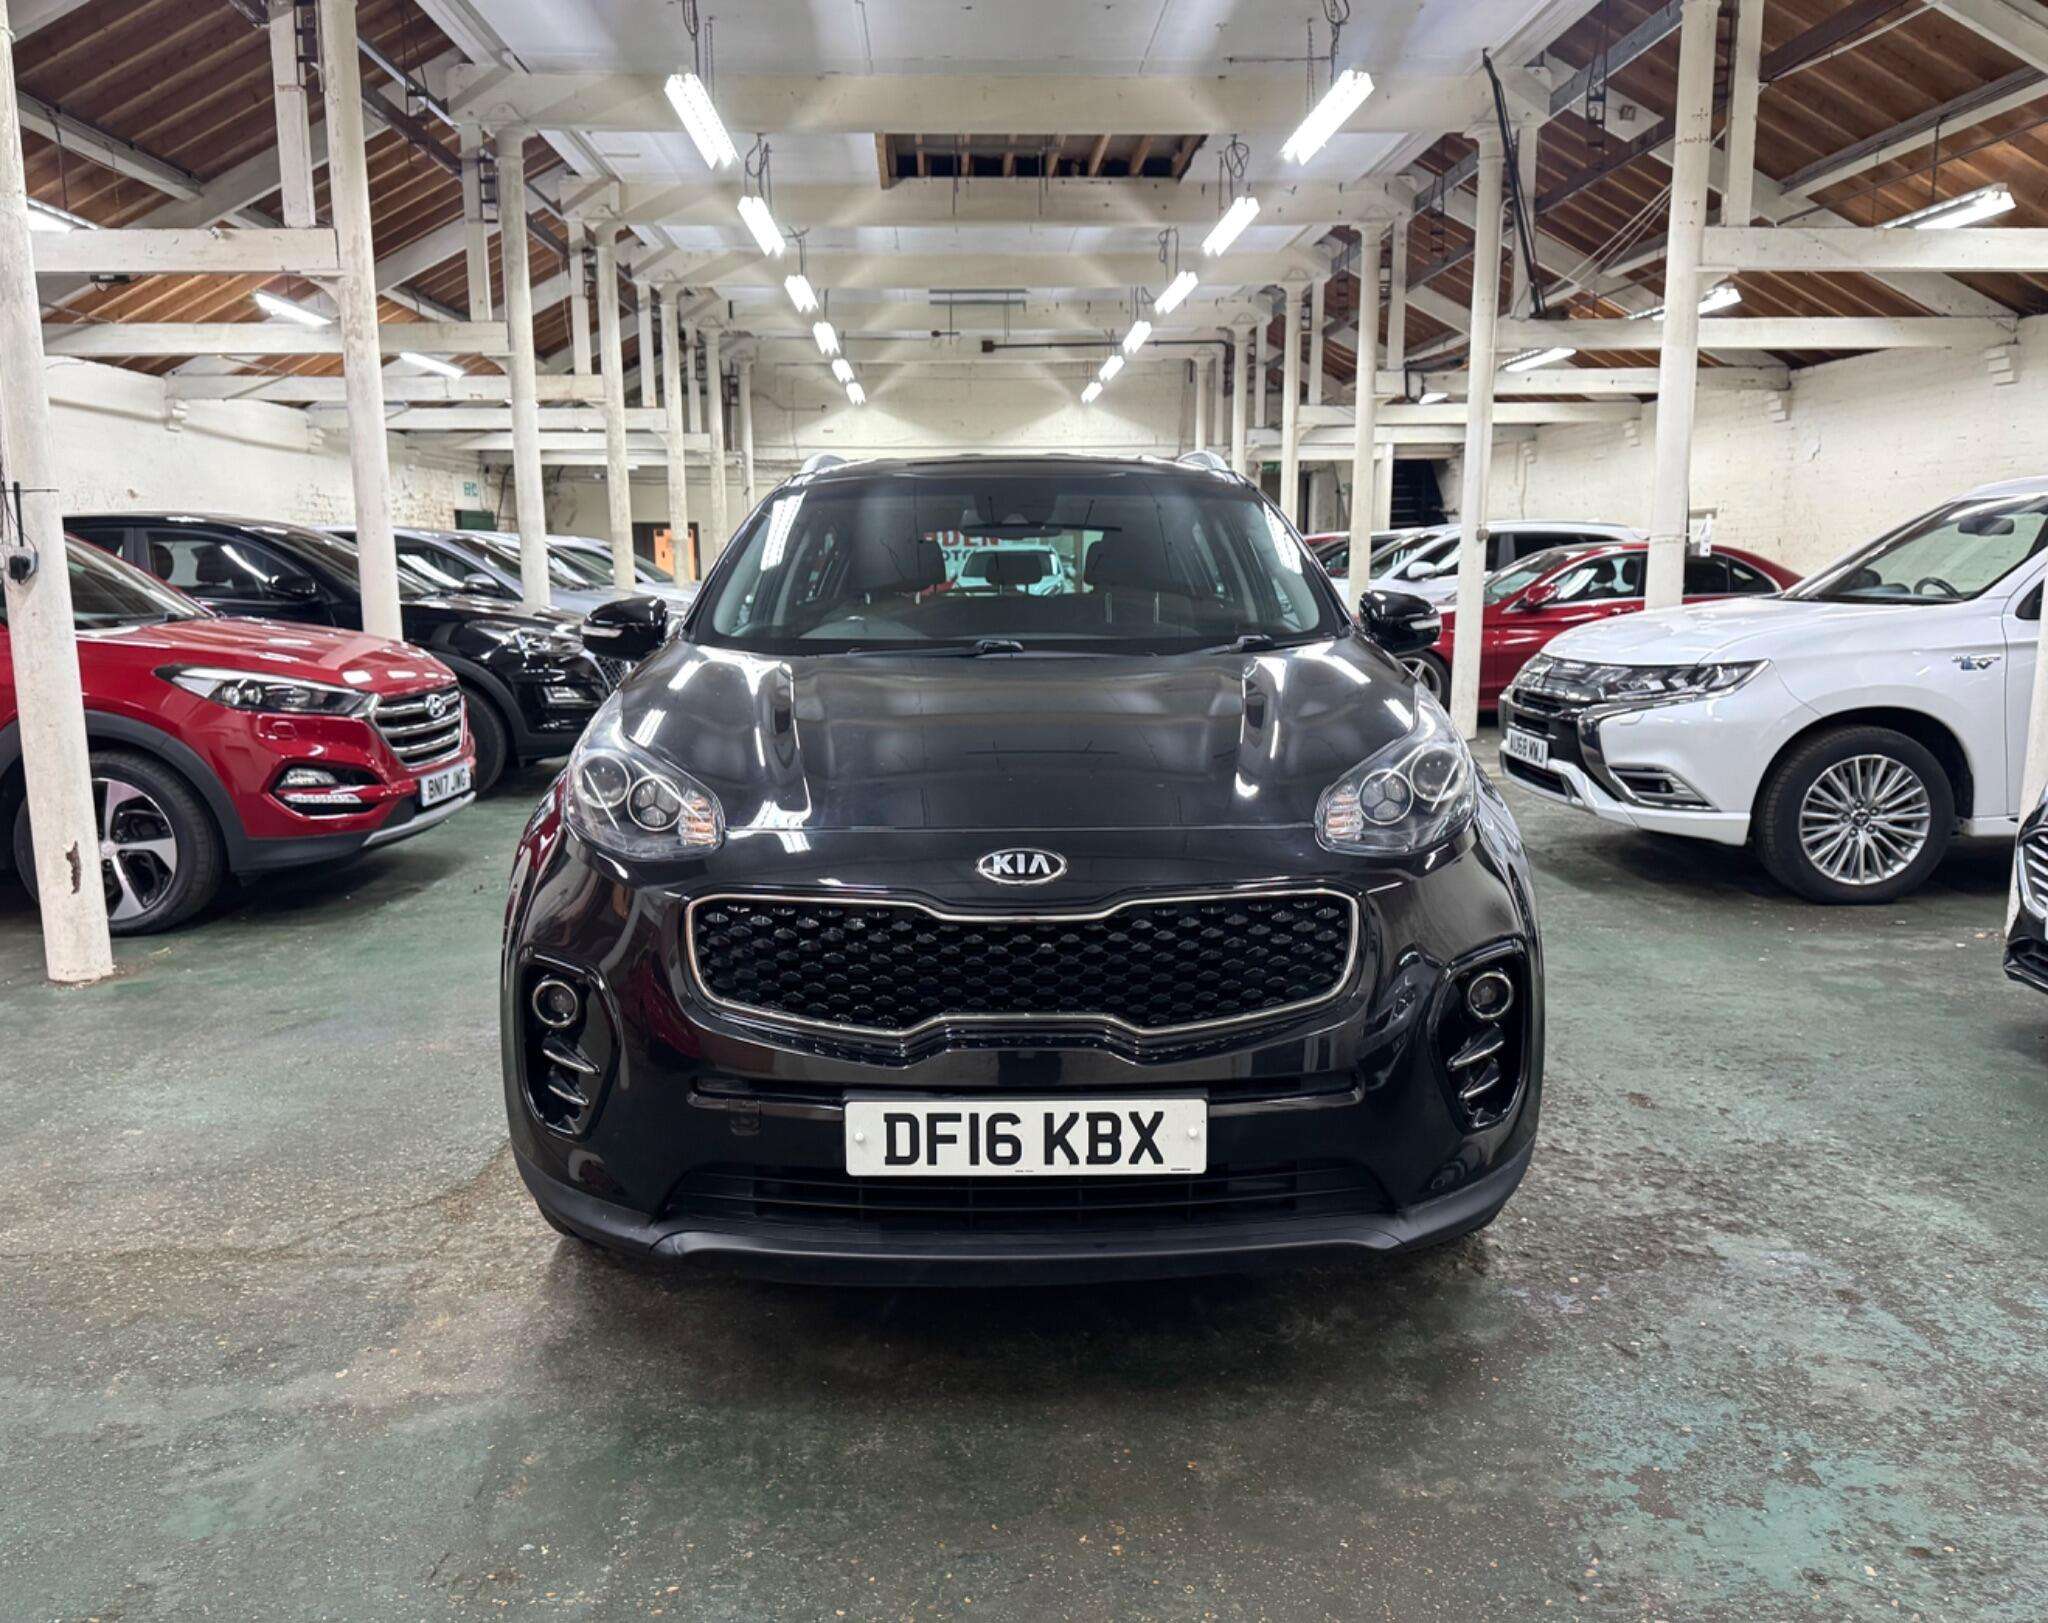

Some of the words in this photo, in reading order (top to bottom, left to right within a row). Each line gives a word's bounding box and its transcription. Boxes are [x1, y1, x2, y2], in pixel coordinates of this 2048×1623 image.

[993, 853, 1051, 874] KIA
[884, 1112, 1022, 1166] DF16
[1043, 1111, 1165, 1165] KBX
